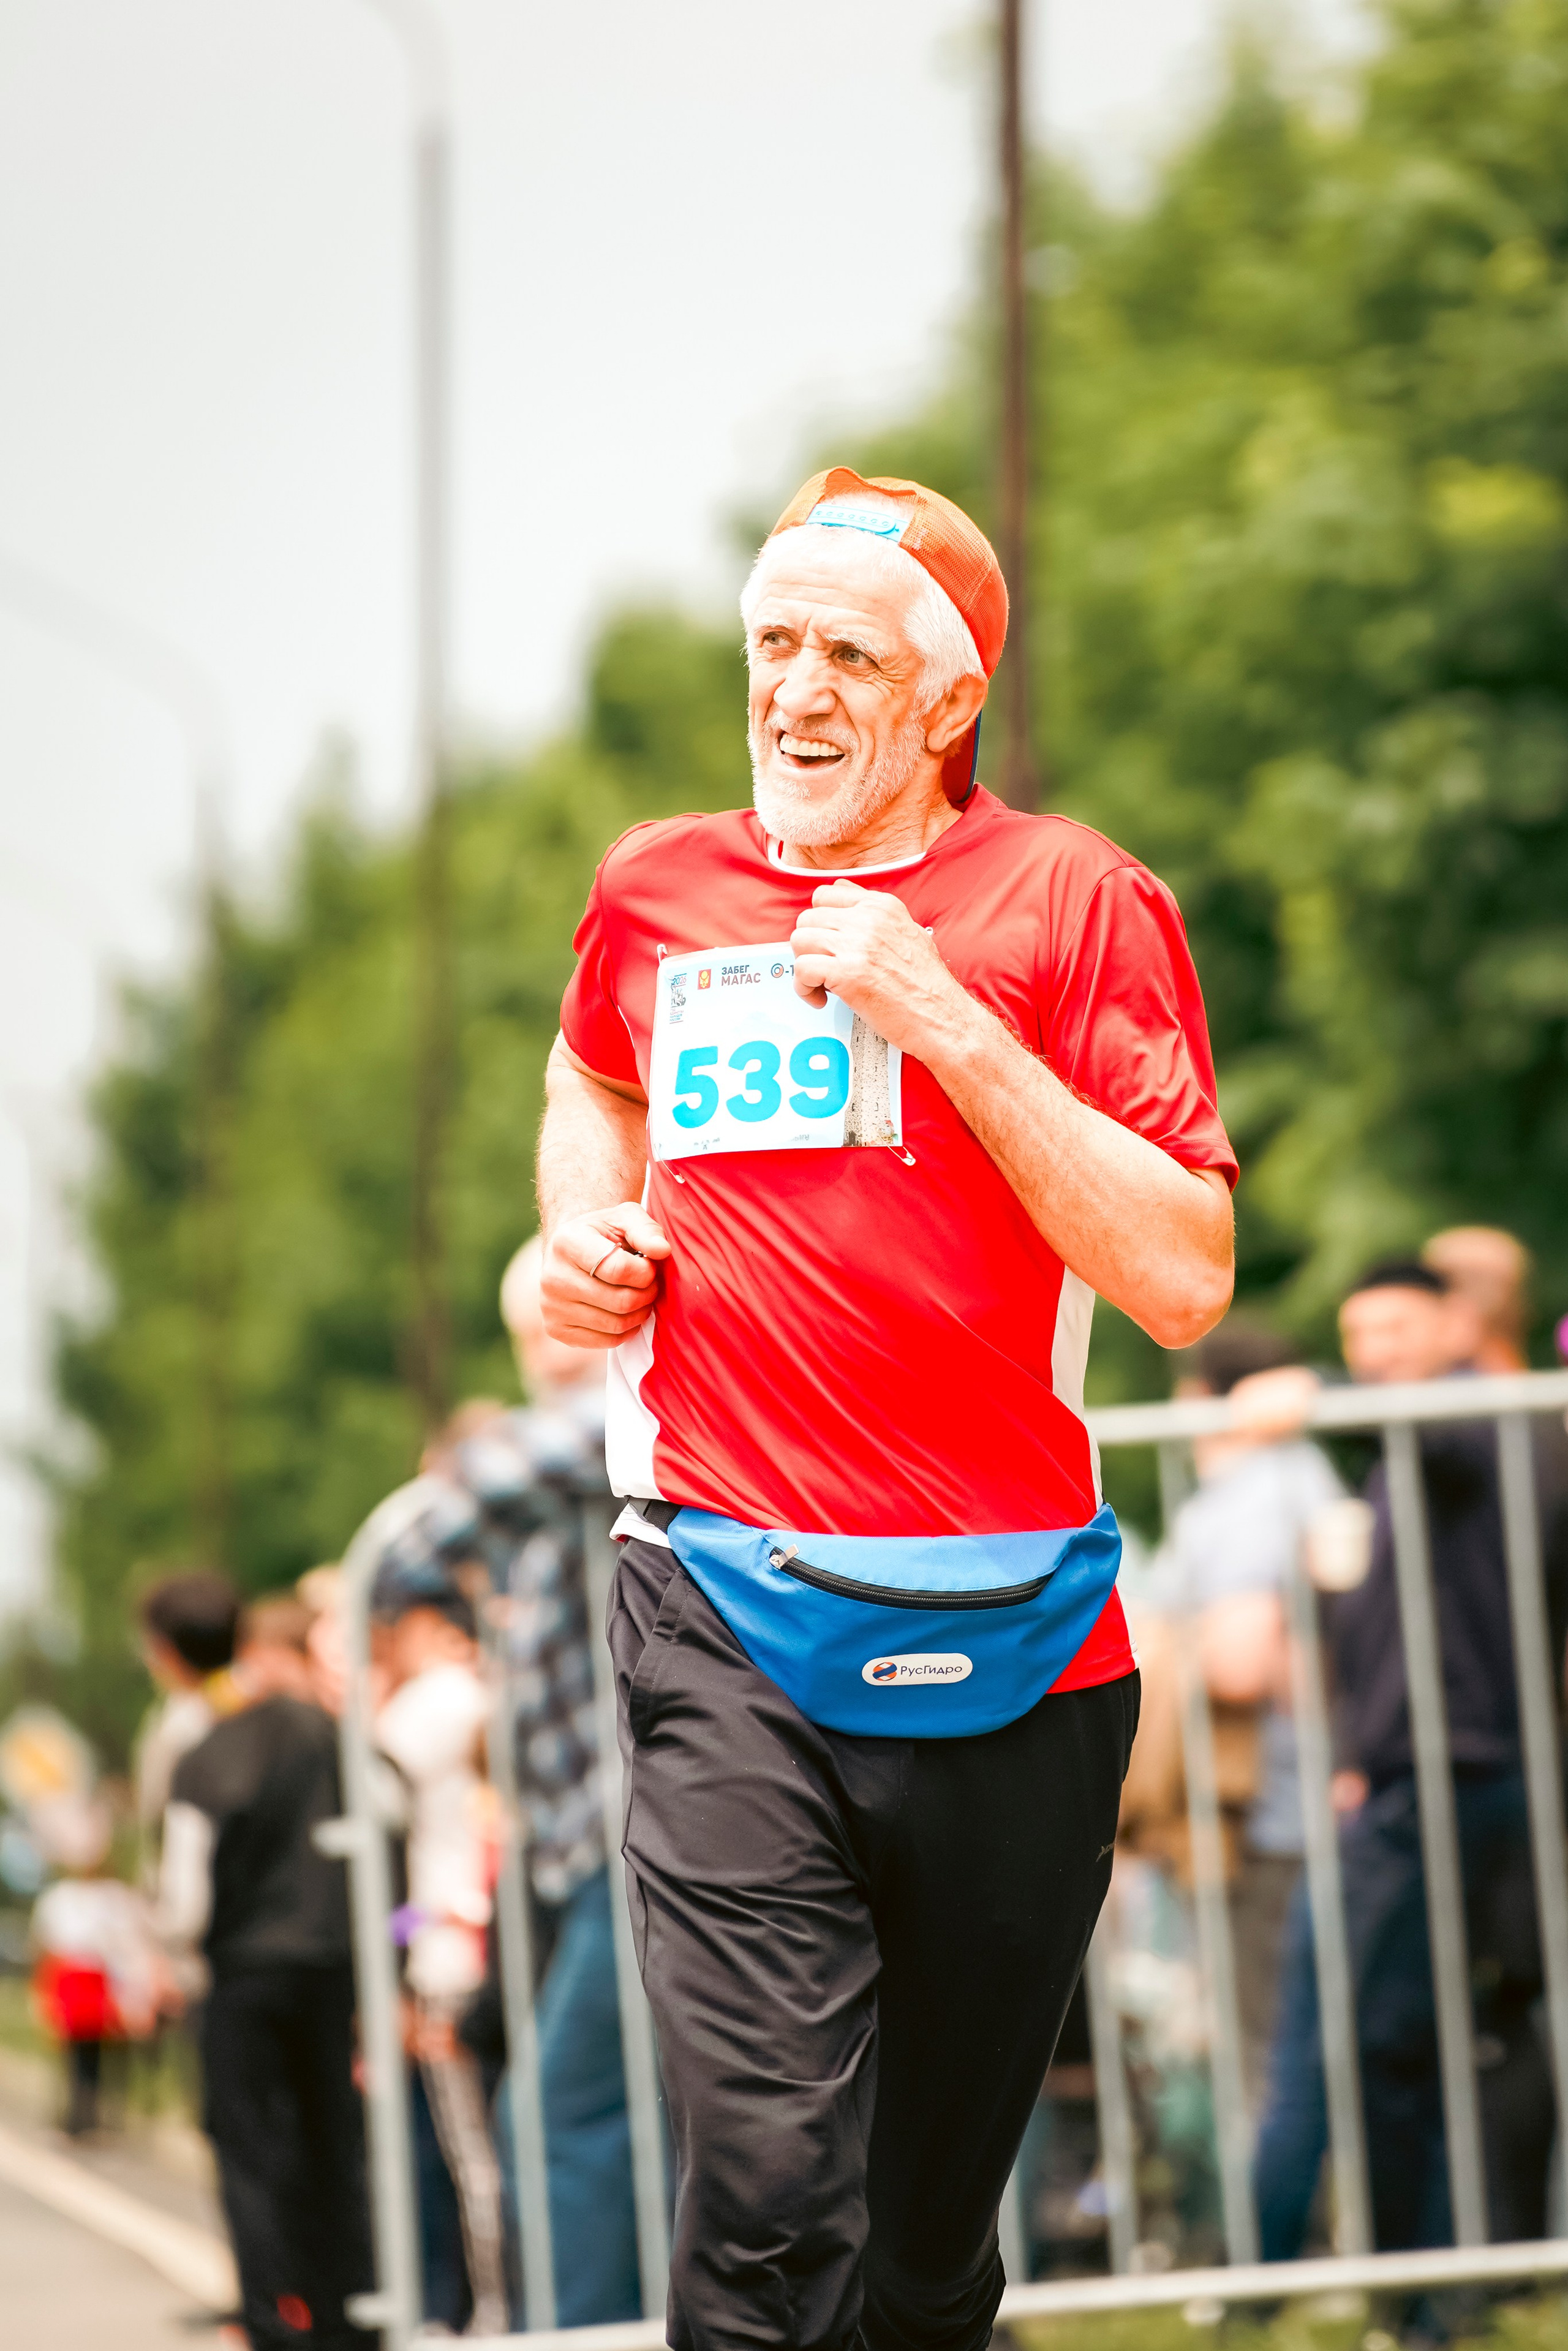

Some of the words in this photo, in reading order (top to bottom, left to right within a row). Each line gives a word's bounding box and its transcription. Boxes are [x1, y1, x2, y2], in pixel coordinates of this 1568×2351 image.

[722, 965, 750, 975] ЗАБЕГ
[721, 973, 761, 986] МАГАС
[672, 1036, 850, 1128] 539
[900, 1665, 962, 1677] РусГидро
